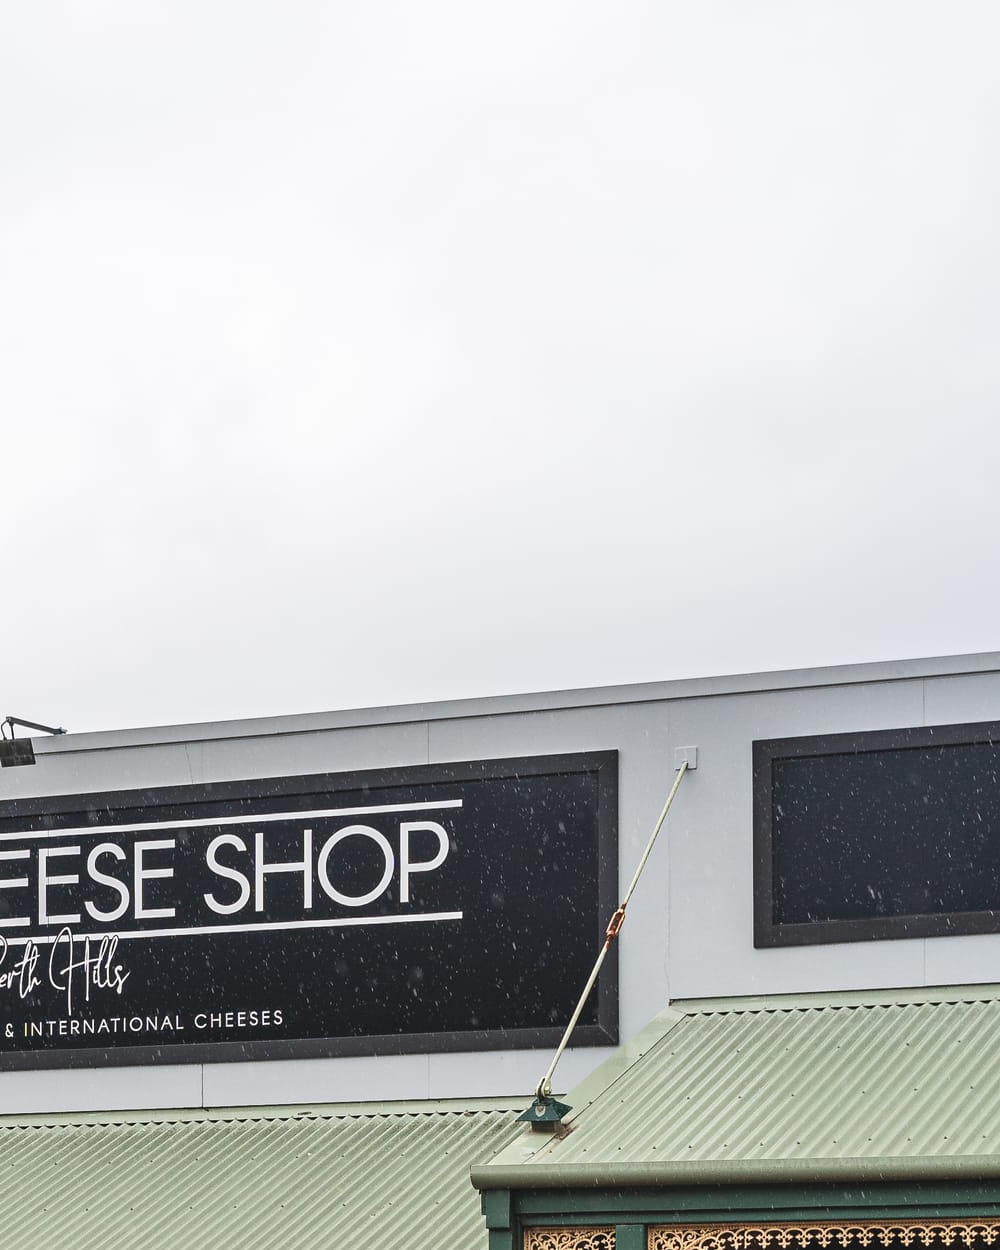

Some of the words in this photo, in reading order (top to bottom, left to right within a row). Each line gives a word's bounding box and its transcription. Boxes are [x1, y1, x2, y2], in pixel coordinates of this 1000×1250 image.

[203, 820, 450, 915] SHOP
[49, 927, 130, 1016] Hills
[5, 1023, 14, 1038] &
[24, 1015, 184, 1037] INTERNATIONAL
[194, 1010, 283, 1029] CHEESES
